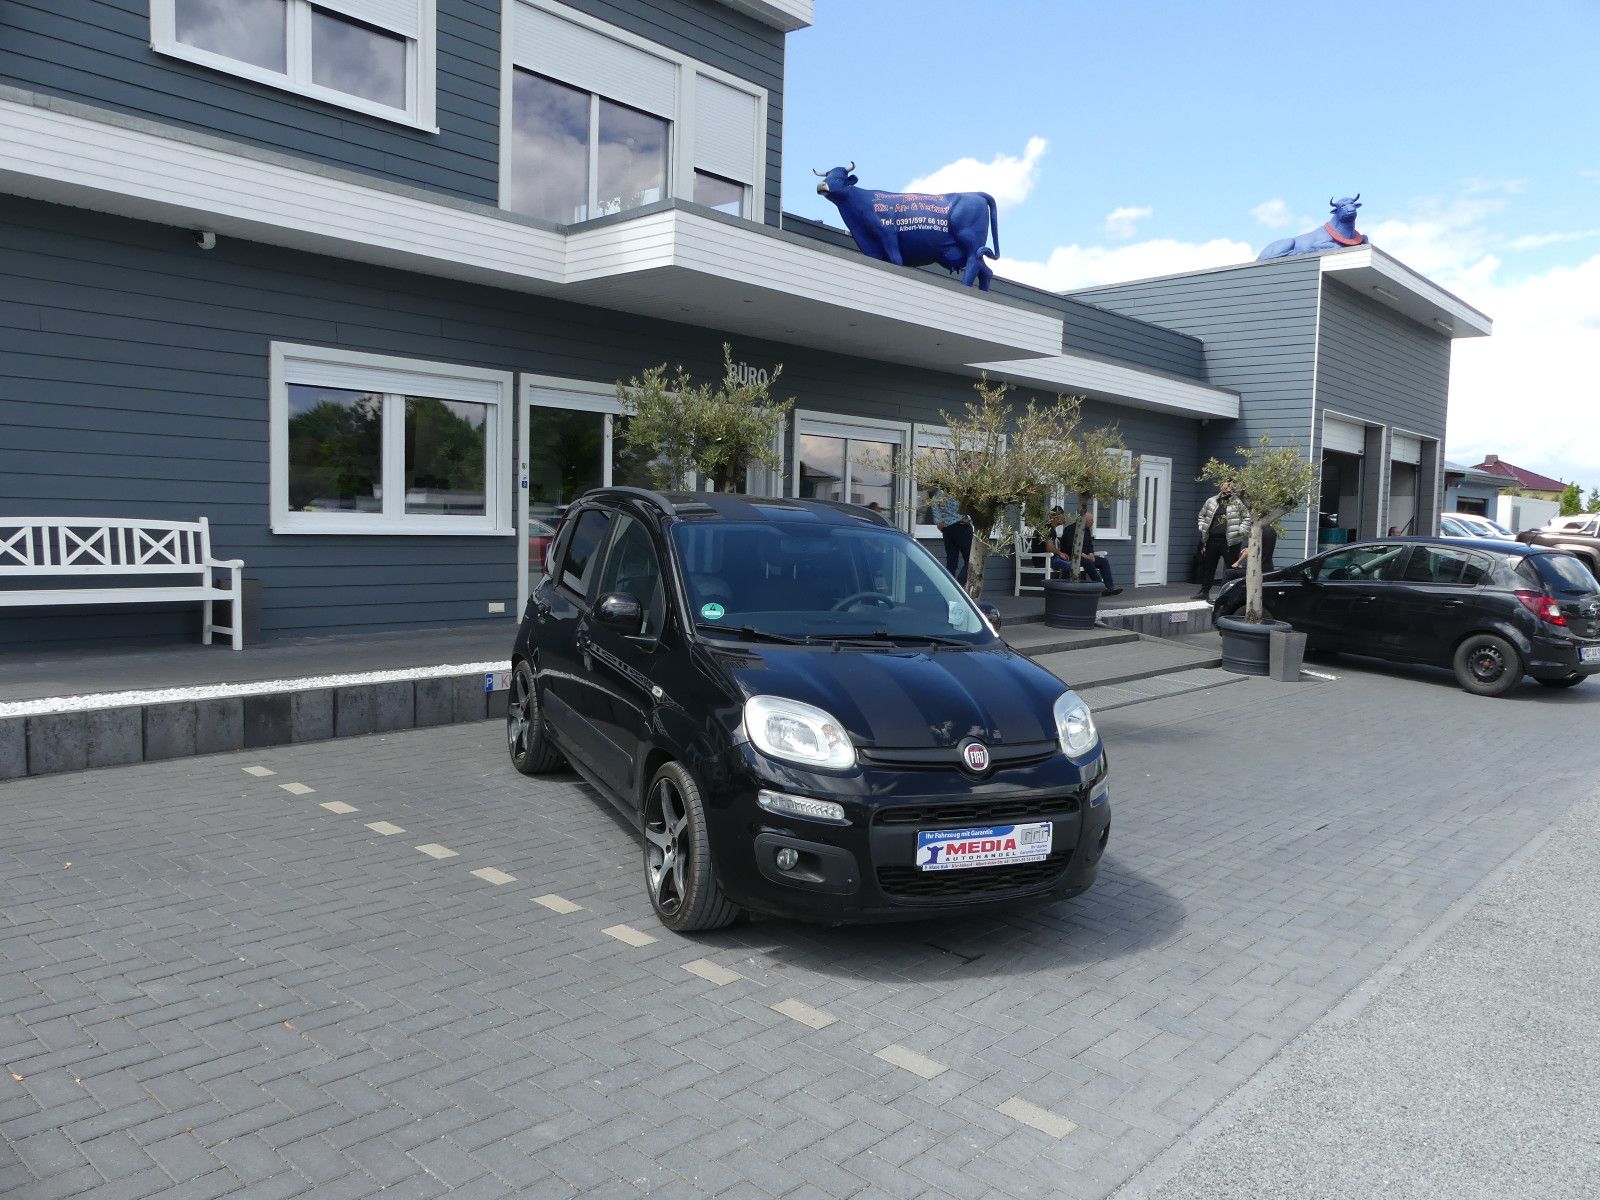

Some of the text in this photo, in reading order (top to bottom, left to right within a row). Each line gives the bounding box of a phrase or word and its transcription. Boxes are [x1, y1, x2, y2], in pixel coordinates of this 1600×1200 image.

[896, 217, 926, 226] 0391/597
[729, 361, 768, 386] BÜRO
[486, 677, 493, 688] P
[969, 751, 984, 764] FIAT
[946, 838, 1017, 856] MEDIA
[945, 852, 1017, 862] AUTOHANDEL
